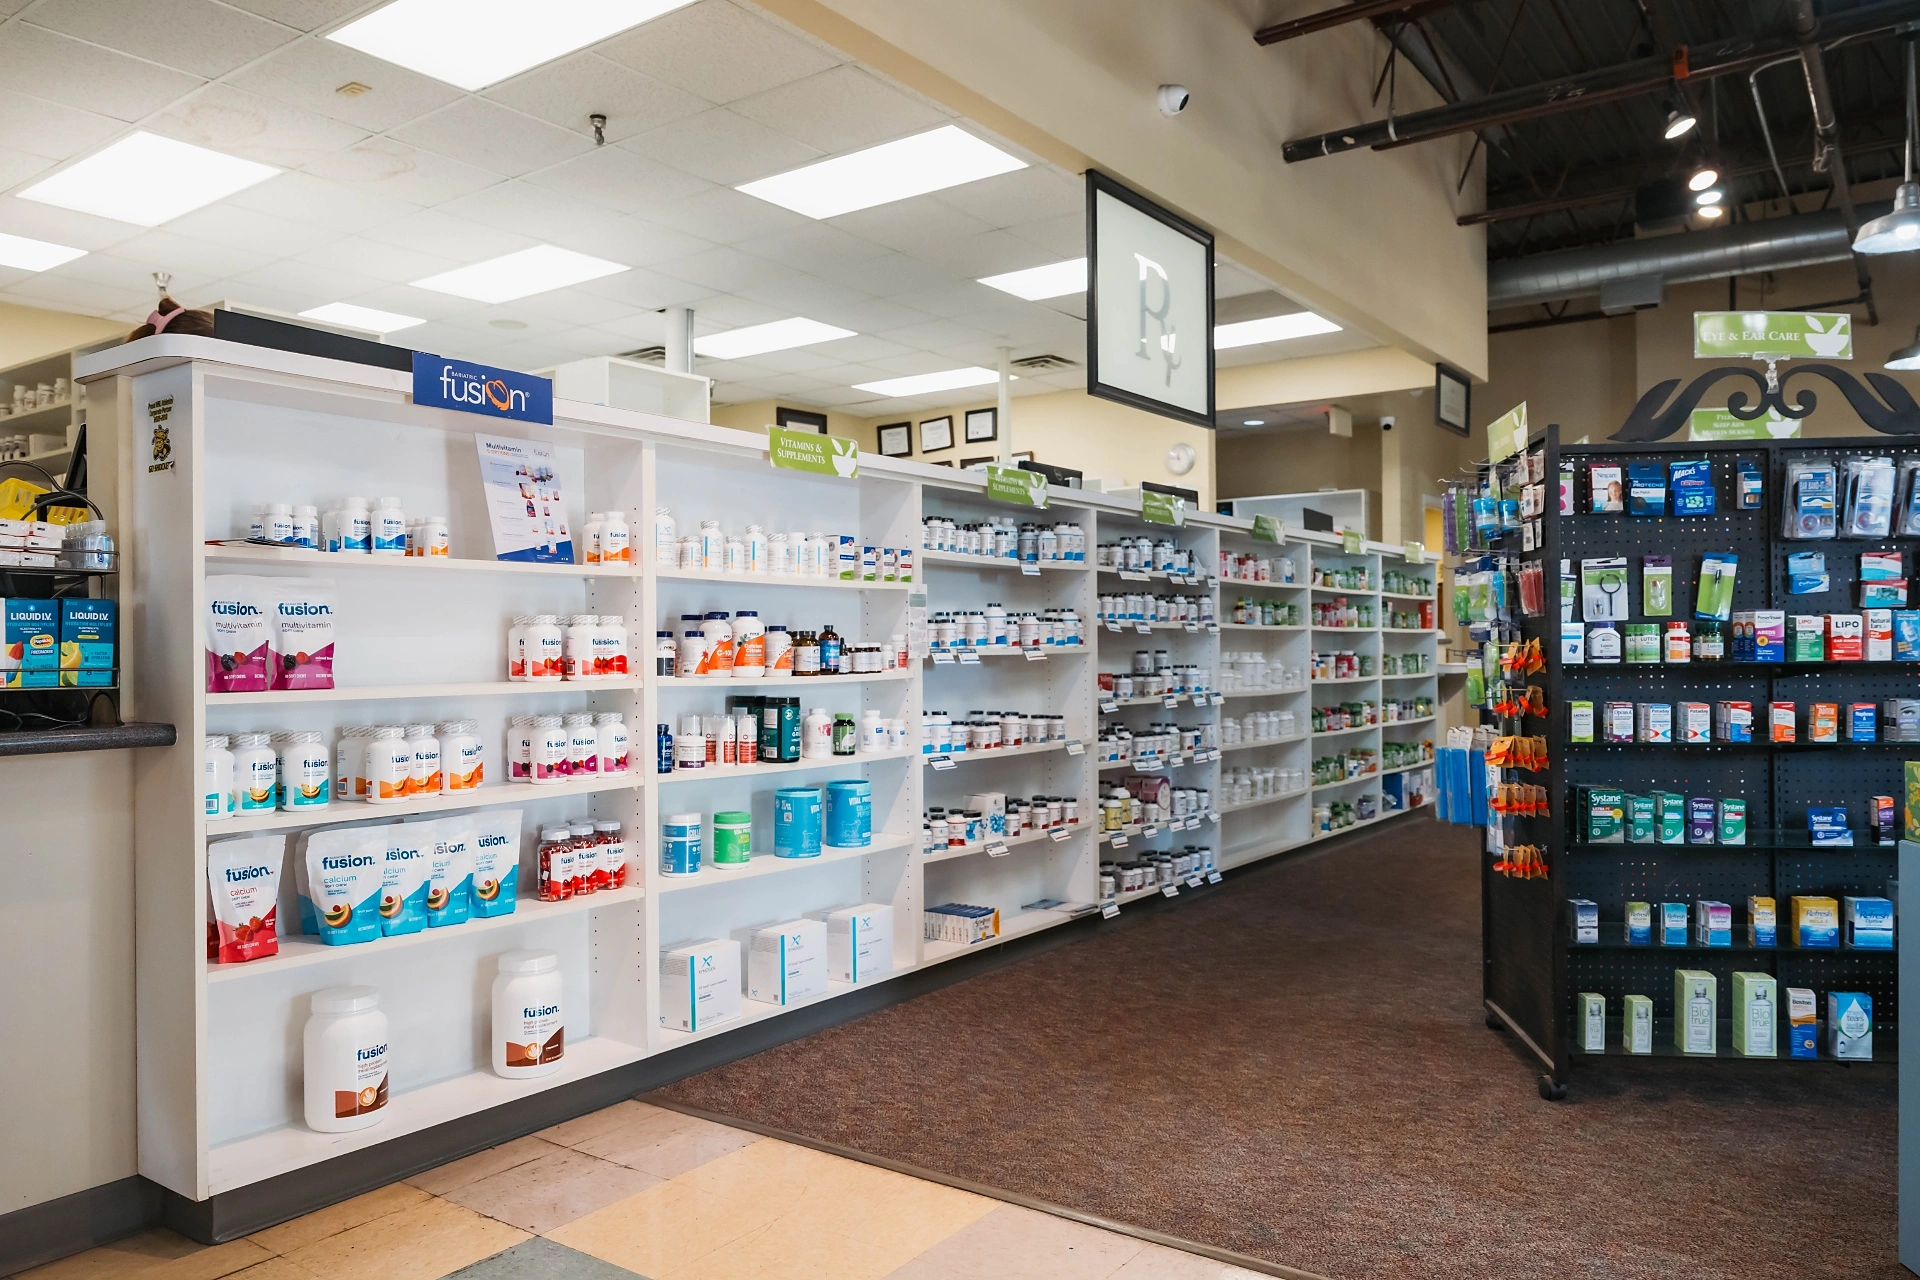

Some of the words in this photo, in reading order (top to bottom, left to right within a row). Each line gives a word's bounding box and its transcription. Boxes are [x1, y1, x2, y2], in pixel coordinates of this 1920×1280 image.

[1703, 331, 1725, 341] EYE
[1729, 332, 1738, 341] &
[1742, 331, 1765, 341] EAR
[1769, 331, 1800, 341] CARE
[452, 371, 478, 380] BARIATRIC
[440, 365, 526, 411] fusion
[486, 442, 522, 453] Multivitamin
[780, 437, 814, 452] VITAMINS
[815, 444, 822, 453] &
[777, 447, 826, 465] SUPPLEMENTS
[993, 482, 1026, 496] SUPPLEMENTS
[211, 600, 258, 615] fusion
[278, 602, 330, 615] fusion
[10, 612, 41, 621] LIQUID
[42, 612, 52, 621] I.V.
[69, 612, 99, 620] LIQUID
[99, 613, 109, 621] I.V.
[215, 621, 263, 629] multivitamin
[281, 621, 332, 629] multivitamin
[1835, 621, 1860, 629] LIPO
[1591, 793, 1621, 806] Systane
[1663, 798, 1684, 806] Systane
[1634, 801, 1653, 809] Systane
[1692, 801, 1714, 809] Systane
[1724, 803, 1745, 811] Systane
[1811, 815, 1833, 824] Systane
[478, 835, 506, 847] usion
[322, 855, 373, 870] fusion
[226, 865, 270, 882] fusion
[324, 875, 357, 884] calcium
[230, 887, 258, 897] calcium
[1859, 911, 1890, 920] Refresh
[1691, 1006, 1710, 1017] Bio
[1752, 1009, 1770, 1019] Bio
[1691, 1017, 1710, 1025] true
[1752, 1019, 1770, 1027] true
[357, 1043, 388, 1061] fusion
